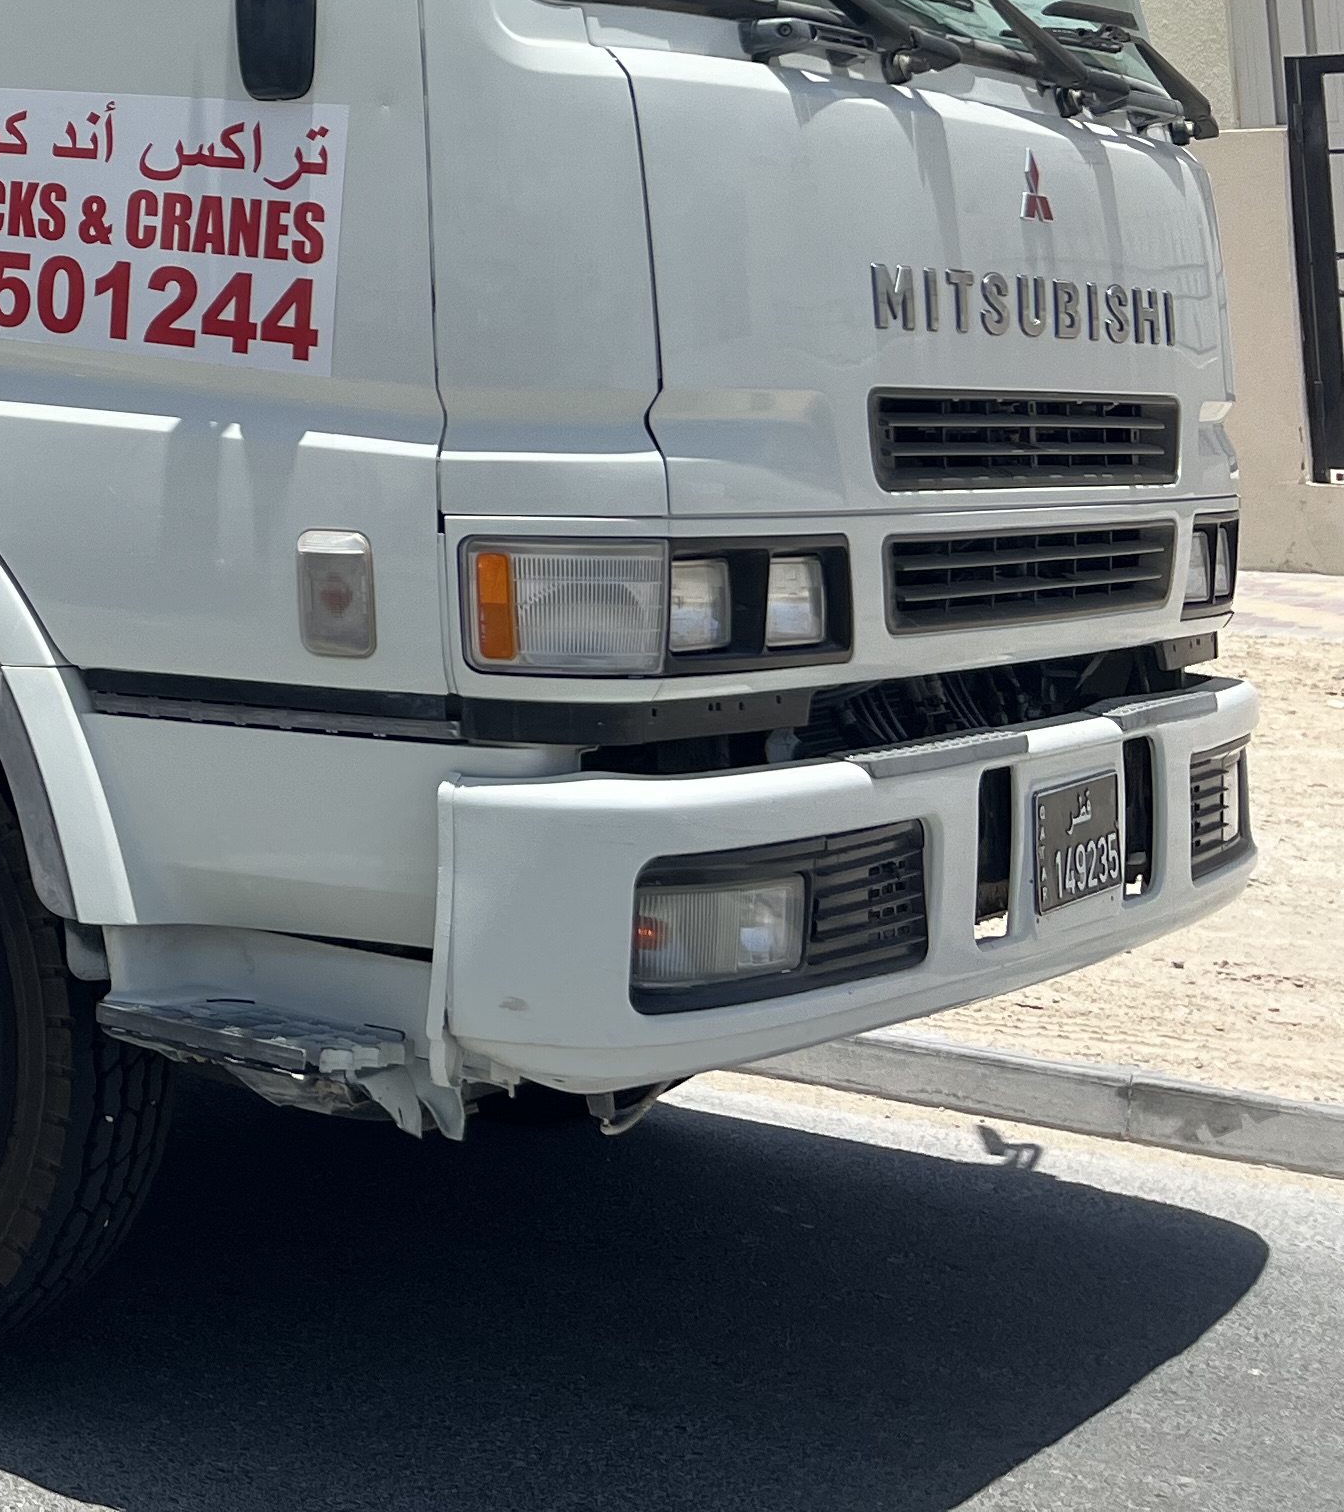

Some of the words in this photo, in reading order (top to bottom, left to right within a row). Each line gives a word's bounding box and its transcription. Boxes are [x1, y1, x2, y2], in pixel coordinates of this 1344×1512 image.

[52, 100, 117, 161] أند
[139, 122, 329, 190] تراكس
[78, 194, 113, 246] &
[126, 190, 325, 264] CRANES
[870, 262, 1176, 346] MITSUBISHI
[1065, 787, 1092, 835] قطر
[1038, 804, 1049, 903] QATAR
[1054, 832, 1120, 900] 149235
